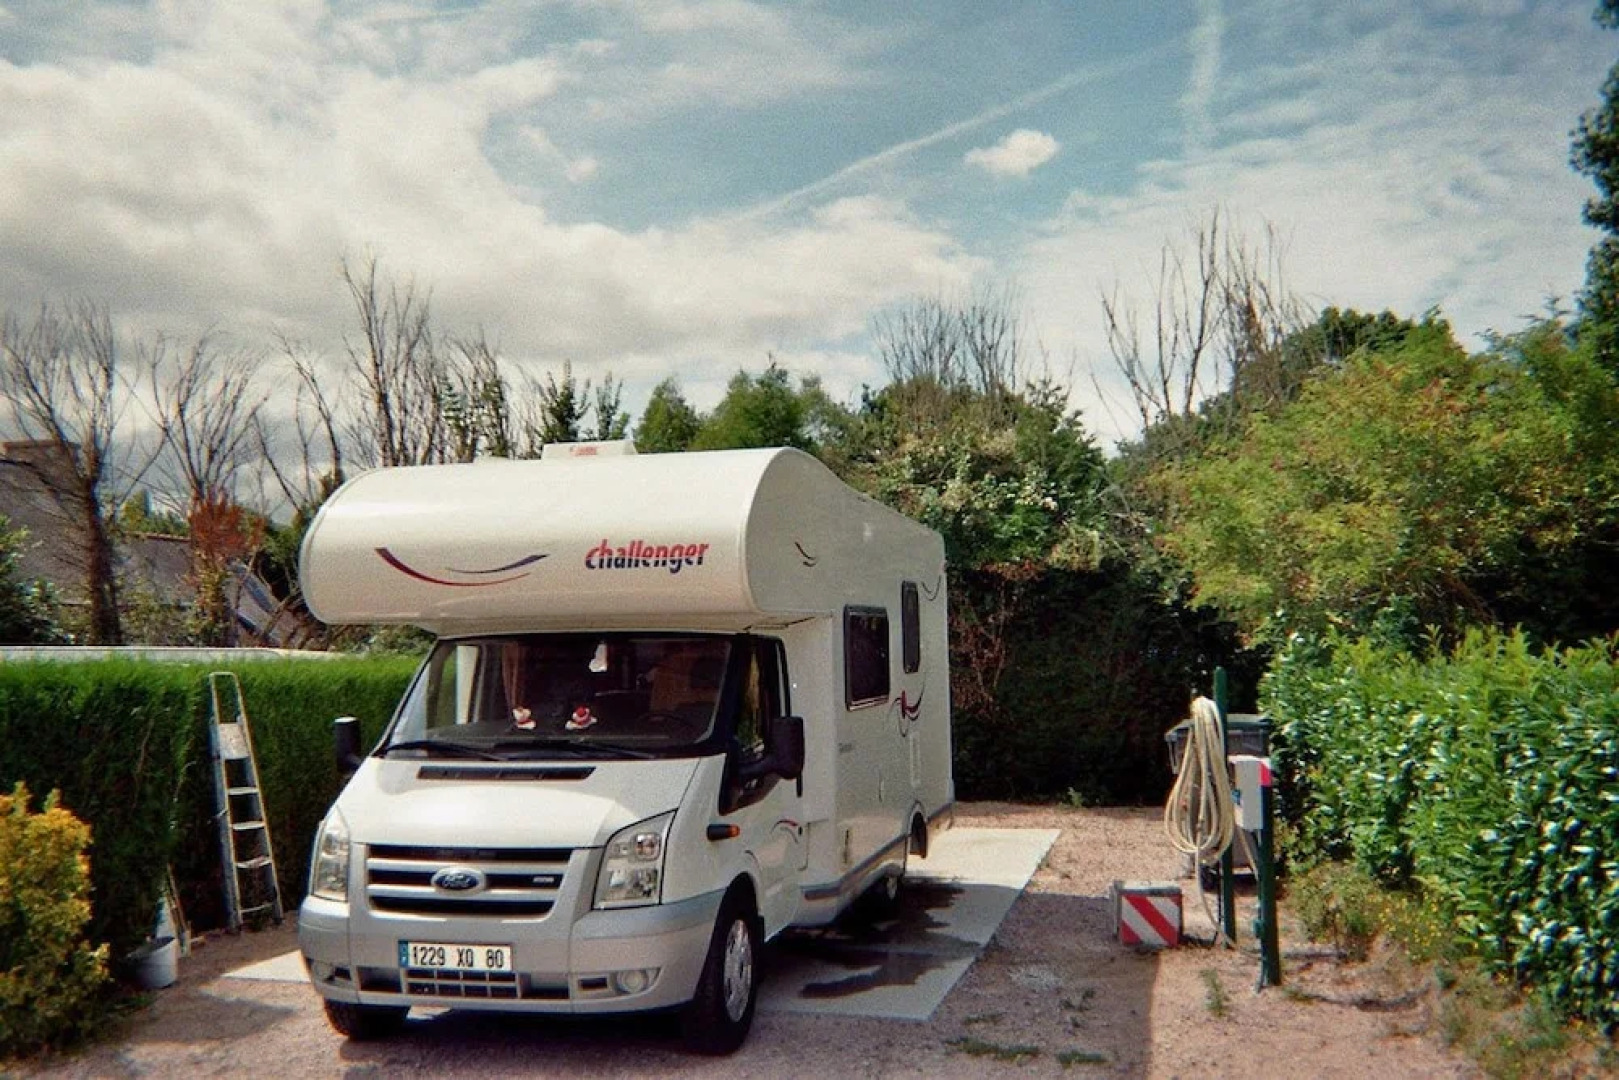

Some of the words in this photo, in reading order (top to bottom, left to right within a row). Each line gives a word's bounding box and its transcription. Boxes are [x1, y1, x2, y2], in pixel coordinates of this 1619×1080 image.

[585, 538, 710, 574] challenger
[412, 946, 446, 967] 1229
[485, 949, 504, 969] 80
